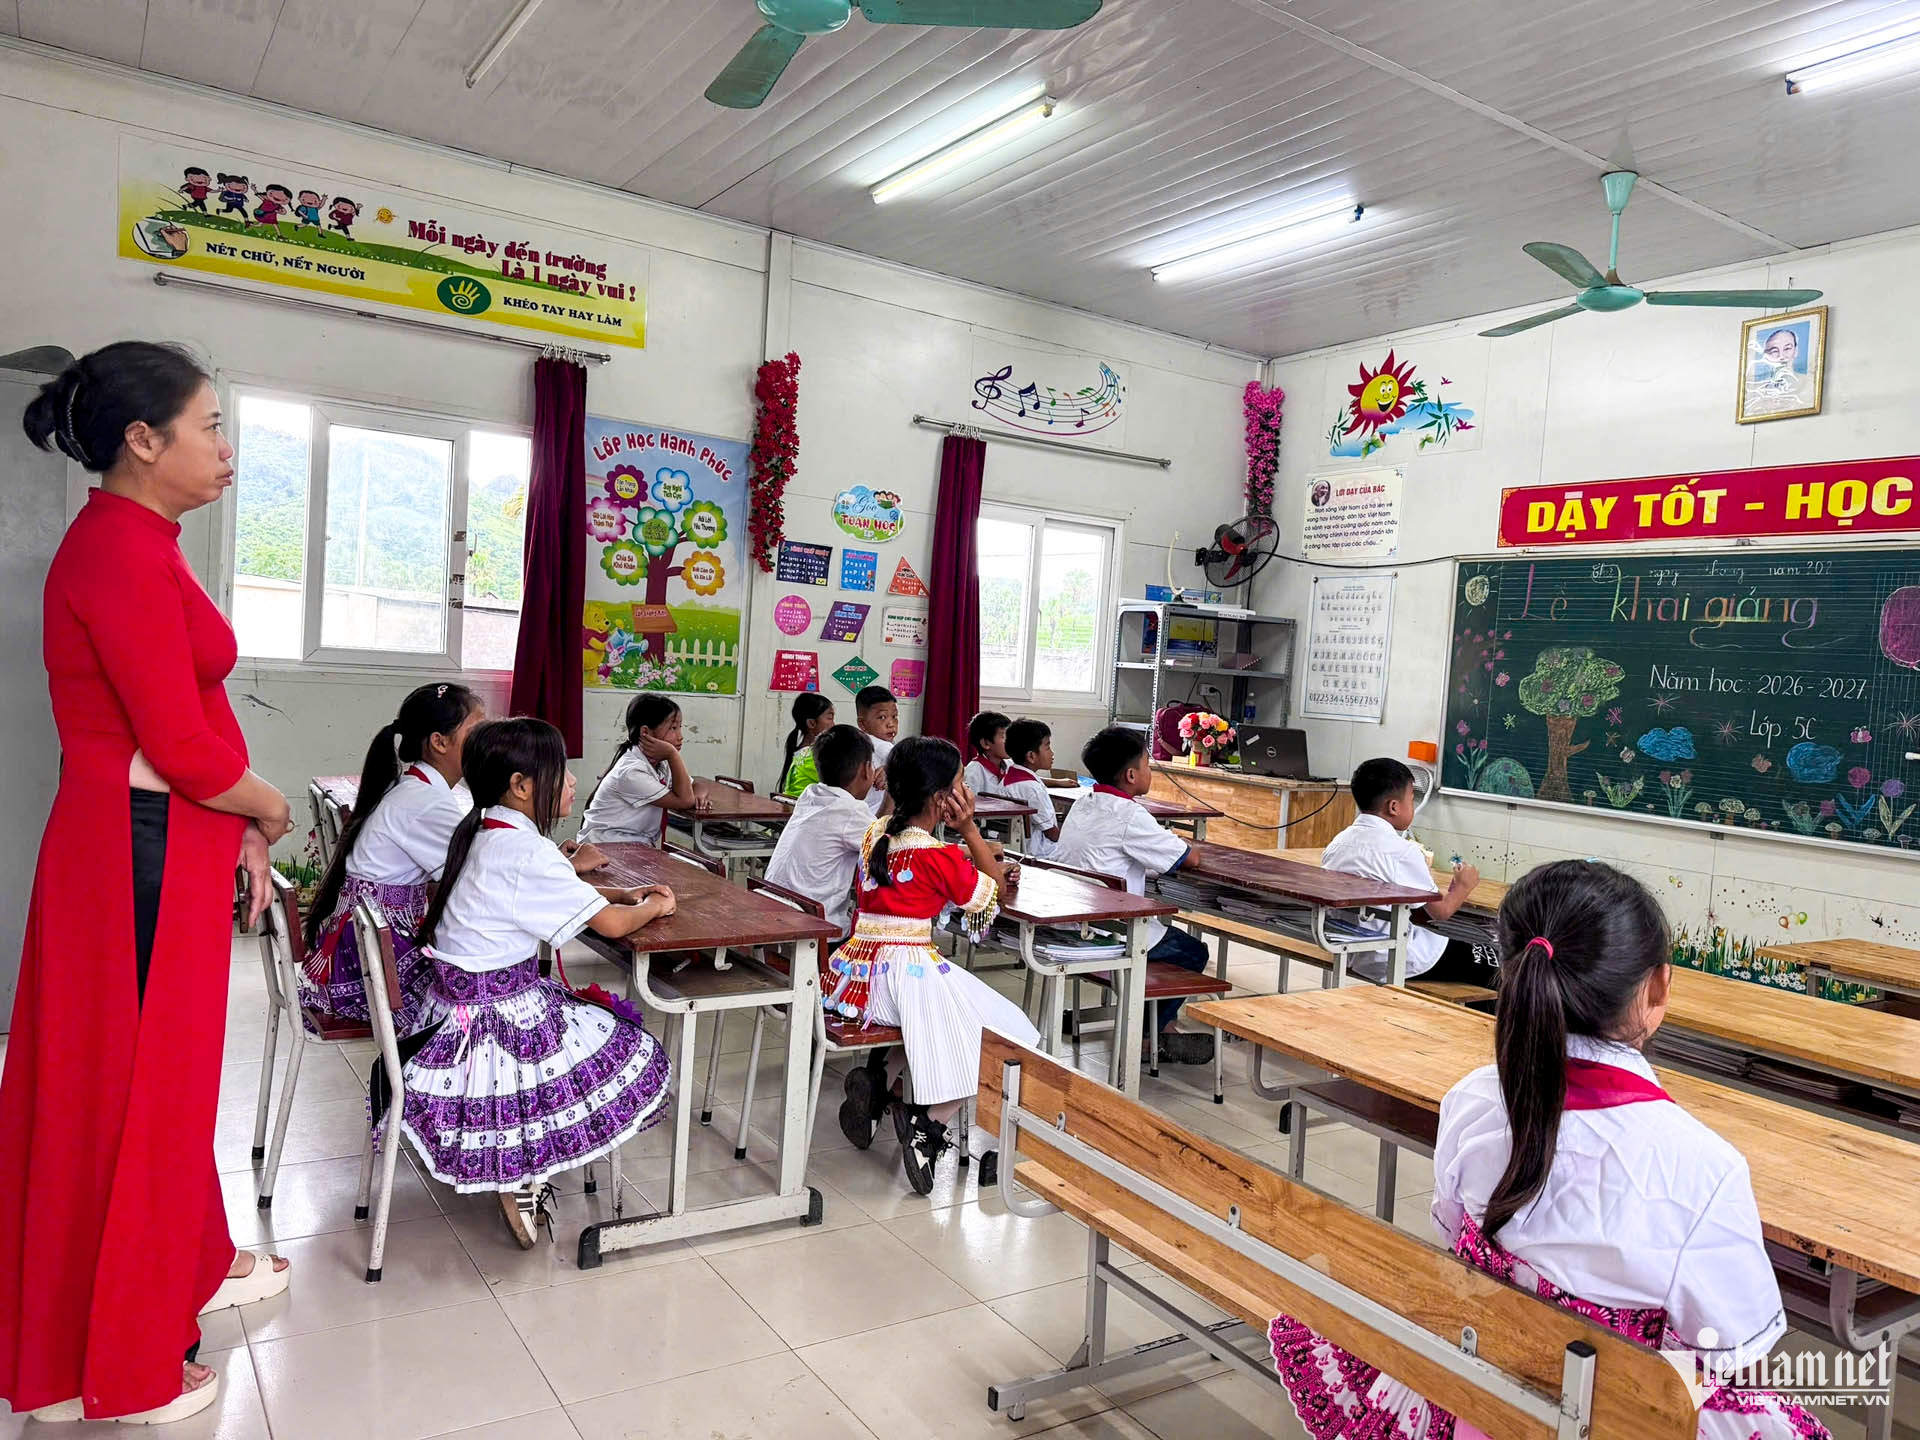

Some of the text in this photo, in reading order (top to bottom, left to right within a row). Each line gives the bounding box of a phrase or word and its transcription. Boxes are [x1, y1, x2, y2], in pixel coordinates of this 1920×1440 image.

[407, 219, 607, 281] Mỗi ngày đến trường
[316, 263, 365, 281] NGƯỜI
[501, 259, 525, 280] Là
[547, 273, 592, 297] ngày
[596, 283, 625, 300] vui
[503, 296, 622, 327] KHÉO TAY HAY LÀM
[1526, 495, 1618, 538] DẠY
[1633, 477, 1727, 528] TỐT
[1784, 476, 1912, 526] HỌC
[1610, 566, 1690, 622] khai
[1650, 664, 1699, 691] Năm
[1791, 716, 1817, 740] 5C
